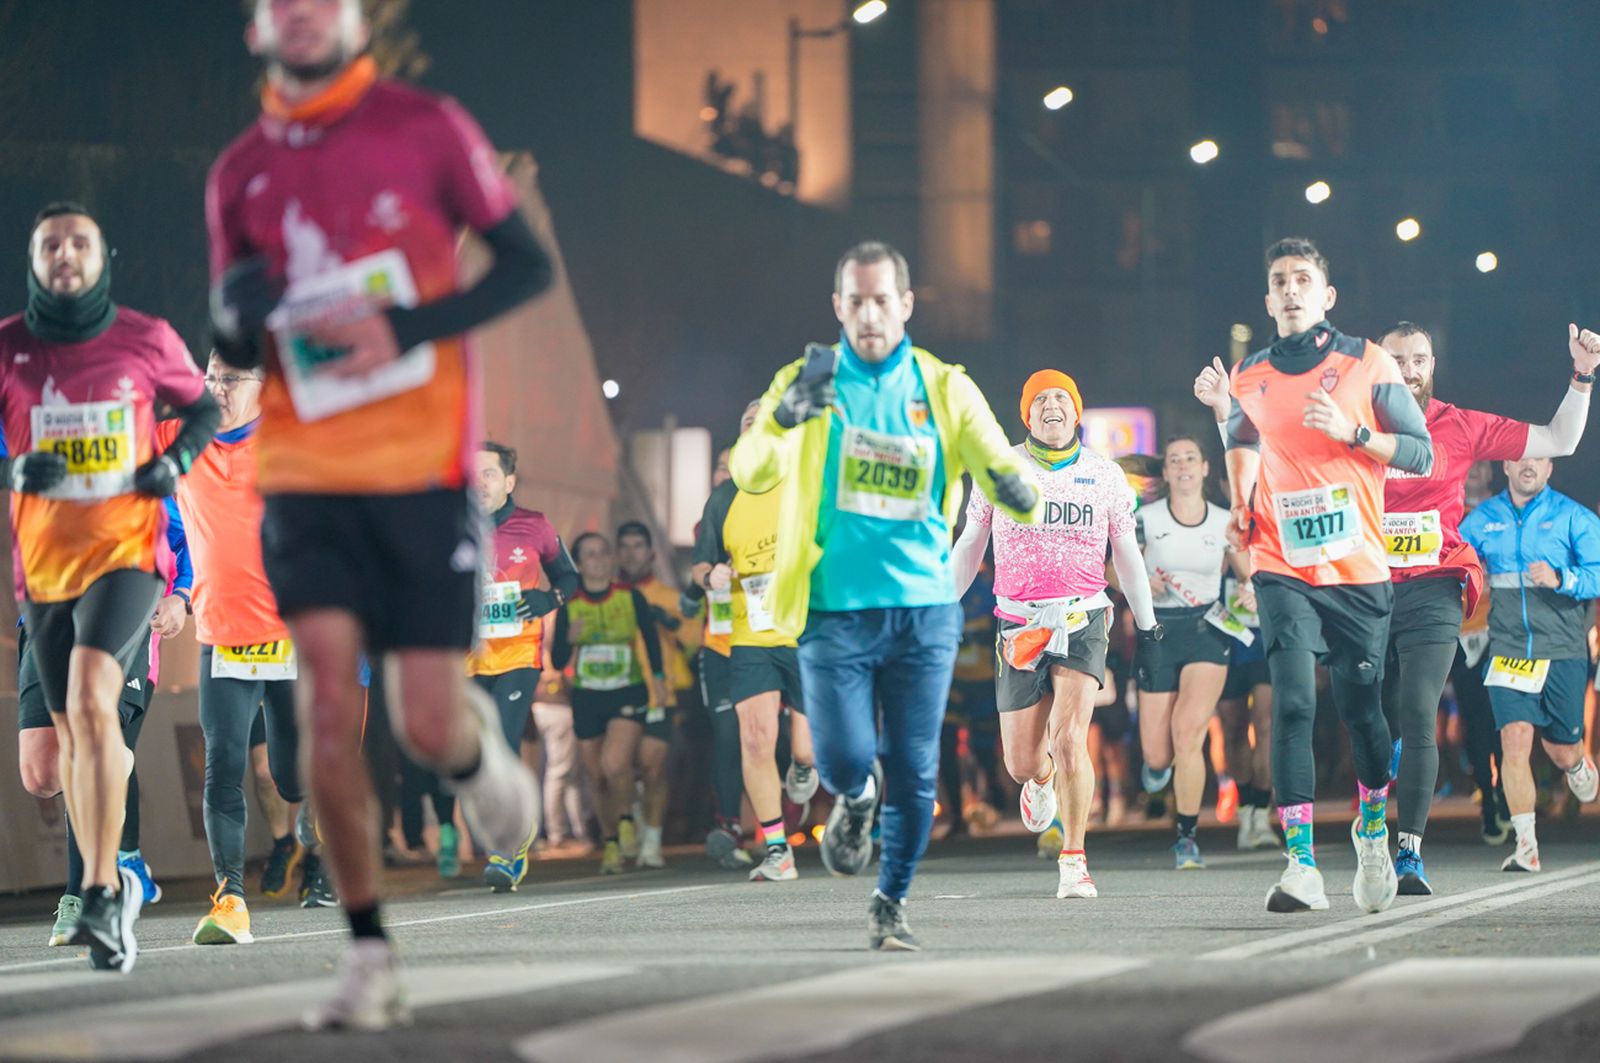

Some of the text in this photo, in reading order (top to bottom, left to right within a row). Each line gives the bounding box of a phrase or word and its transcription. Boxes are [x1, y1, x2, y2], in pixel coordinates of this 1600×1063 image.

[857, 460, 918, 490] 2039
[1290, 498, 1313, 508] NOCHE
[1285, 509, 1299, 518] SAN
[1293, 511, 1344, 540] 12177
[1393, 535, 1421, 552] 271
